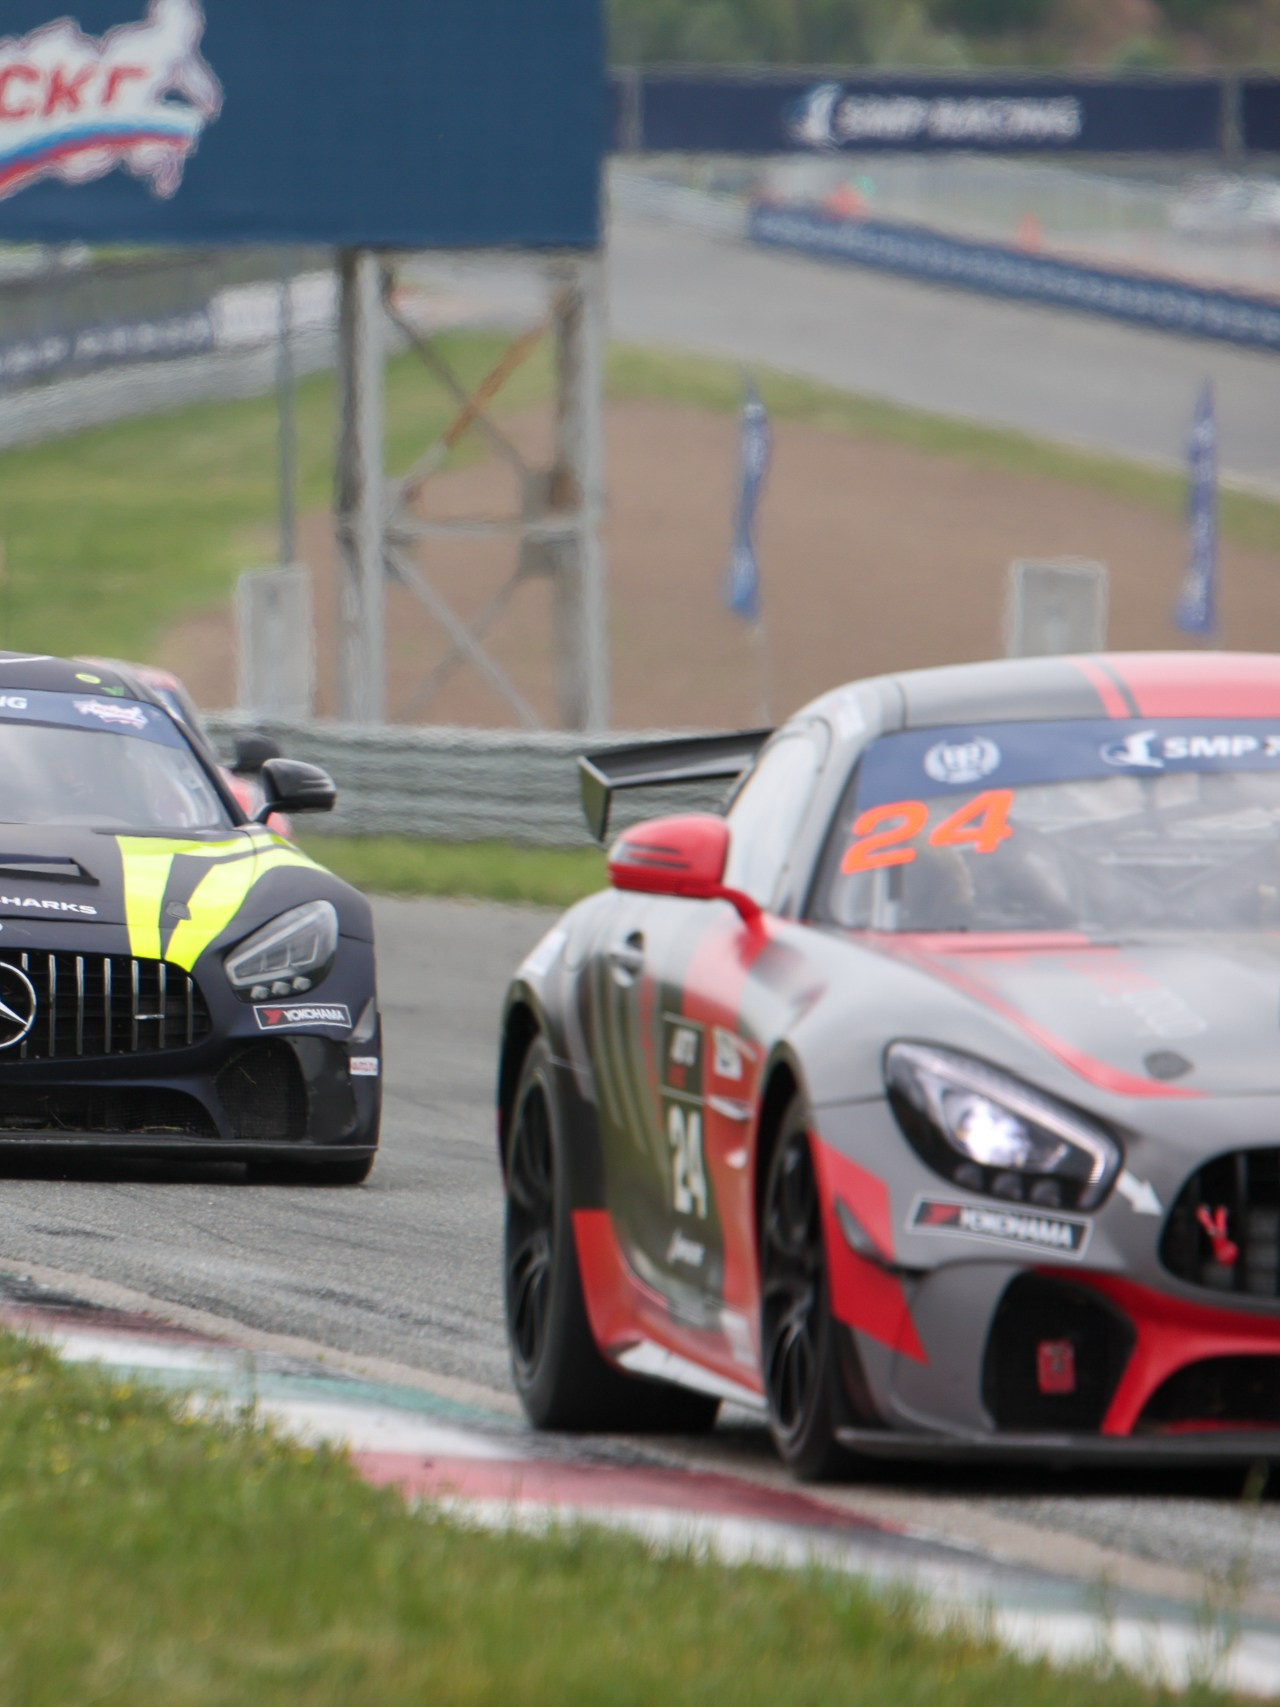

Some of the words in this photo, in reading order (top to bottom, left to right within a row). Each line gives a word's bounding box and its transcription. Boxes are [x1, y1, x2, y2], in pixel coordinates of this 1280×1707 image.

[1164, 735, 1259, 759] SMP
[840, 789, 1014, 874] 24
[283, 1009, 345, 1021] YOKOHAMA
